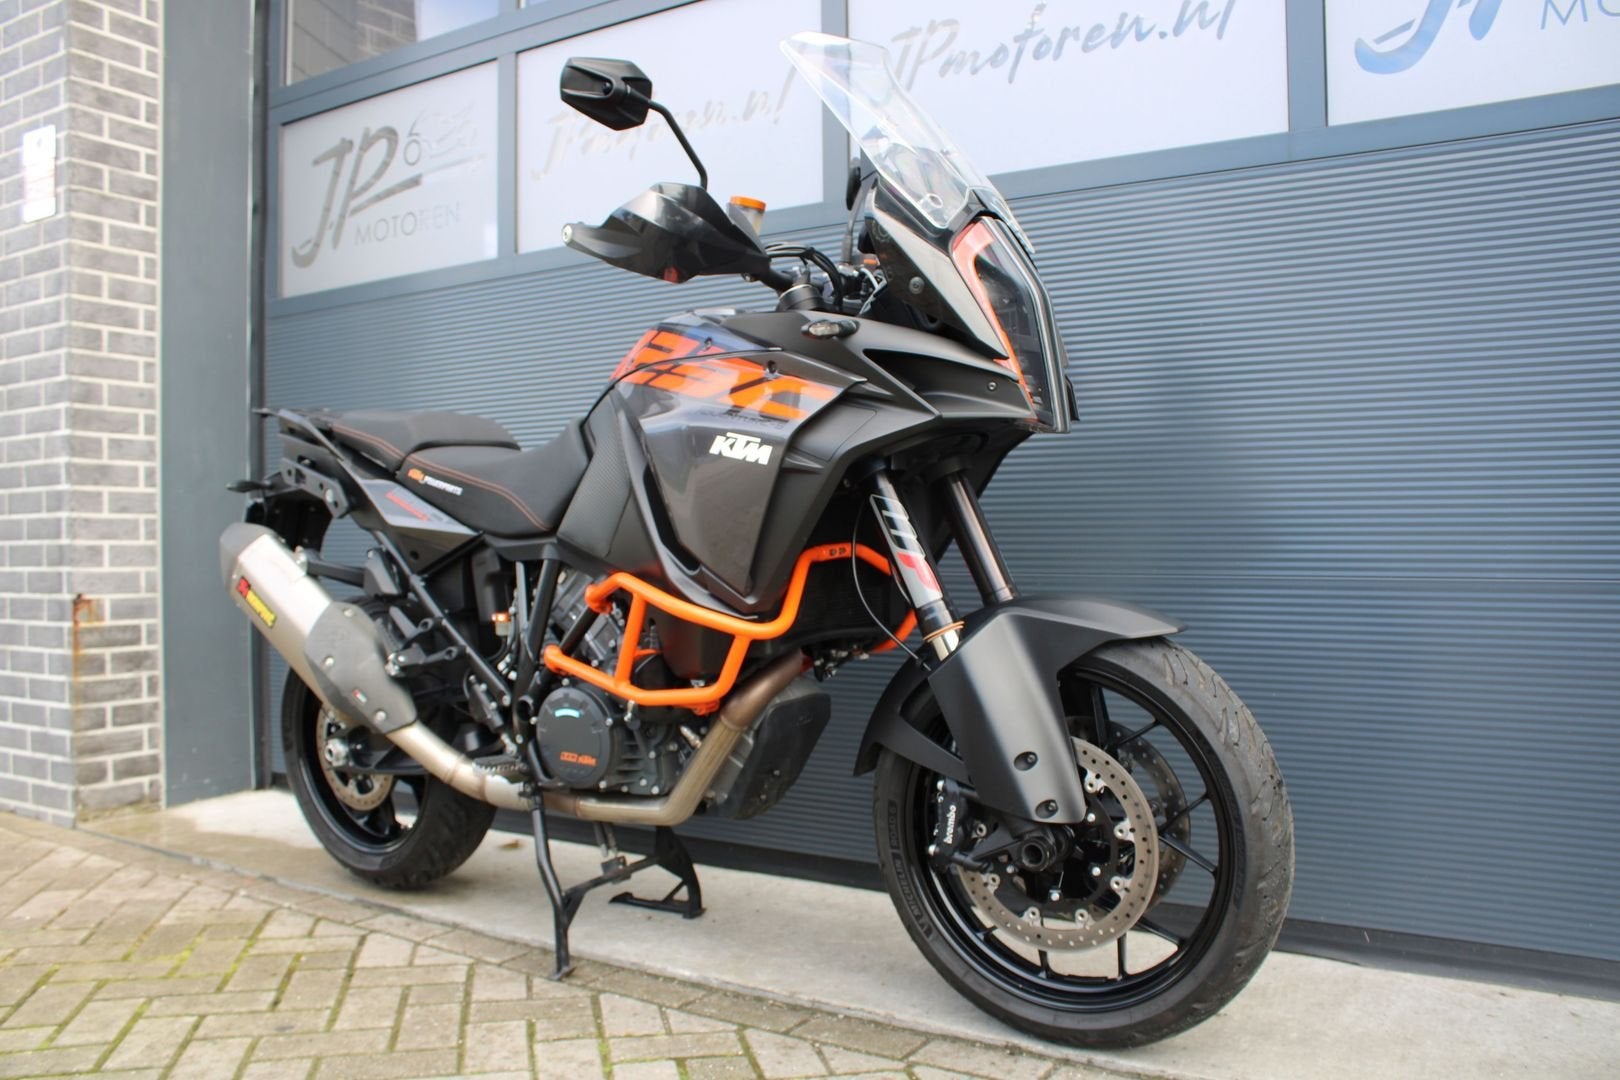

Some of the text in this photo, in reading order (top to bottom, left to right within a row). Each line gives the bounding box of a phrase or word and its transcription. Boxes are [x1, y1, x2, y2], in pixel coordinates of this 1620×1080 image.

[291, 126, 400, 269] JP
[354, 201, 462, 247] MOTOREN
[709, 431, 774, 466] KTM
[943, 804, 957, 845] brembo
